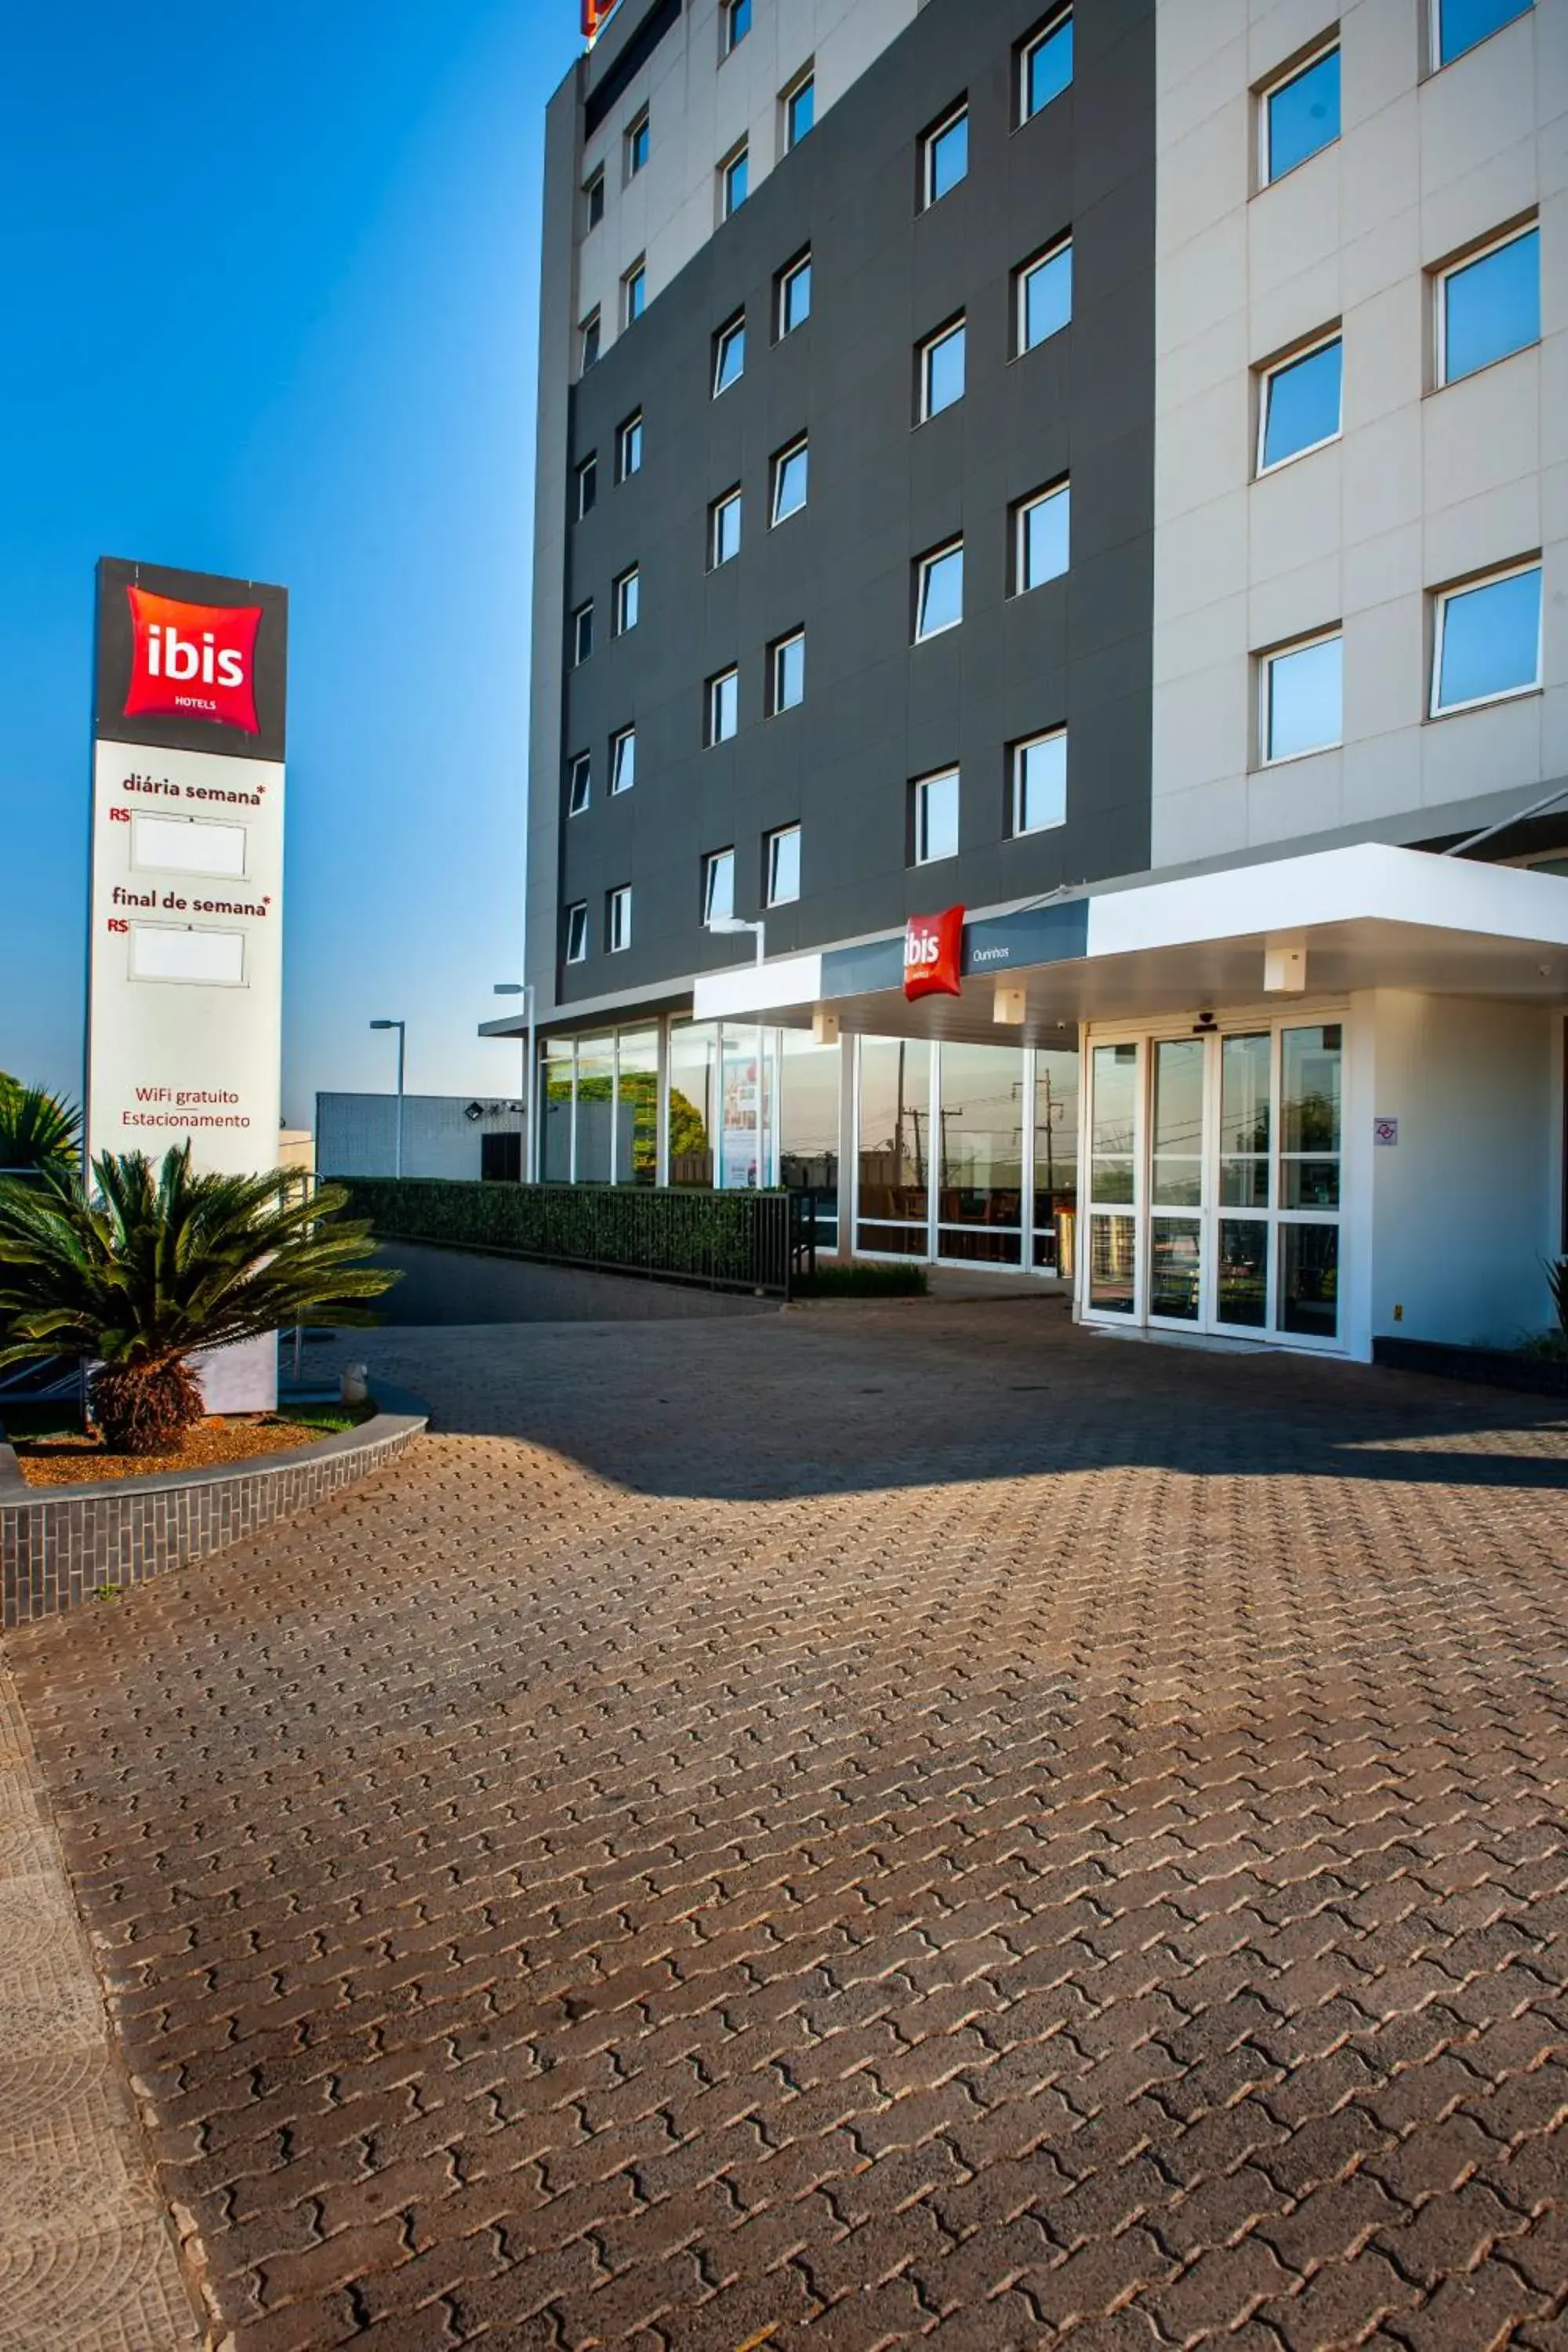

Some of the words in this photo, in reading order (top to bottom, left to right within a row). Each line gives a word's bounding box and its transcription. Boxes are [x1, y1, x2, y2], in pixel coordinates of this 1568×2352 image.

[148, 624, 244, 687] ibis
[175, 696, 216, 710] HOTELS
[122, 773, 180, 797] diária
[109, 808, 130, 822] R$
[112, 887, 156, 907] final
[162, 891, 187, 910] de
[107, 919, 129, 933] R$
[973, 947, 1010, 962] Ourinhos
[136, 1087, 172, 1102] WiFi
[175, 1090, 239, 1105] gratuito
[122, 1112, 251, 1128] Estacionamento
